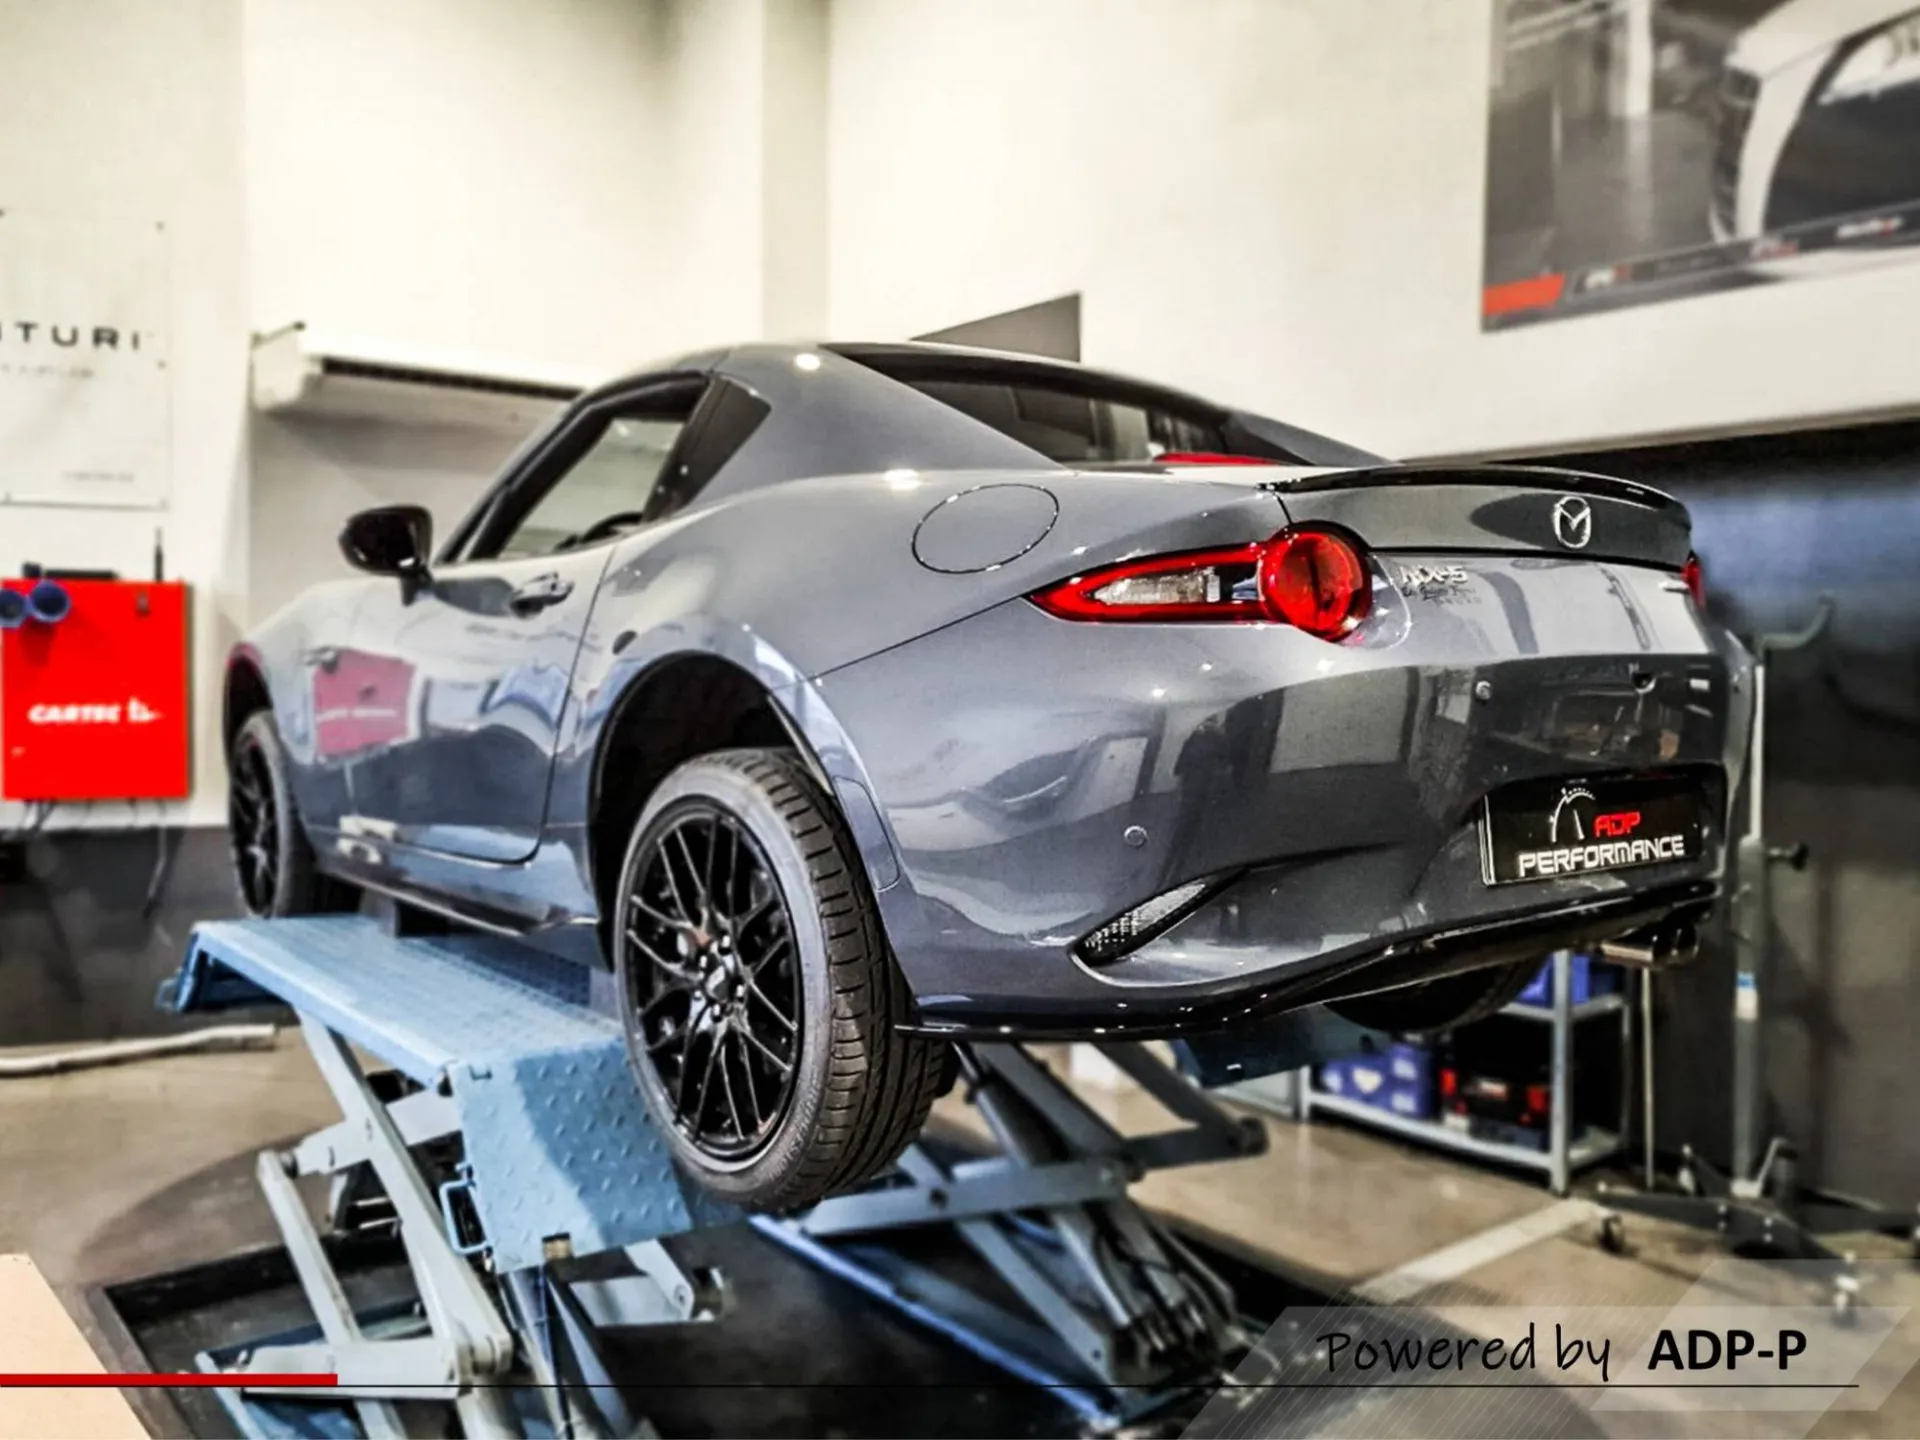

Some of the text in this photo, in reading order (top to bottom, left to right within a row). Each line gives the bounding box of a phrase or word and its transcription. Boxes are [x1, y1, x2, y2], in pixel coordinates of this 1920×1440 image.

[0, 321, 141, 351] TURI
[1594, 811, 1641, 837] ADP
[1519, 834, 1685, 877] PERFORMANCE
